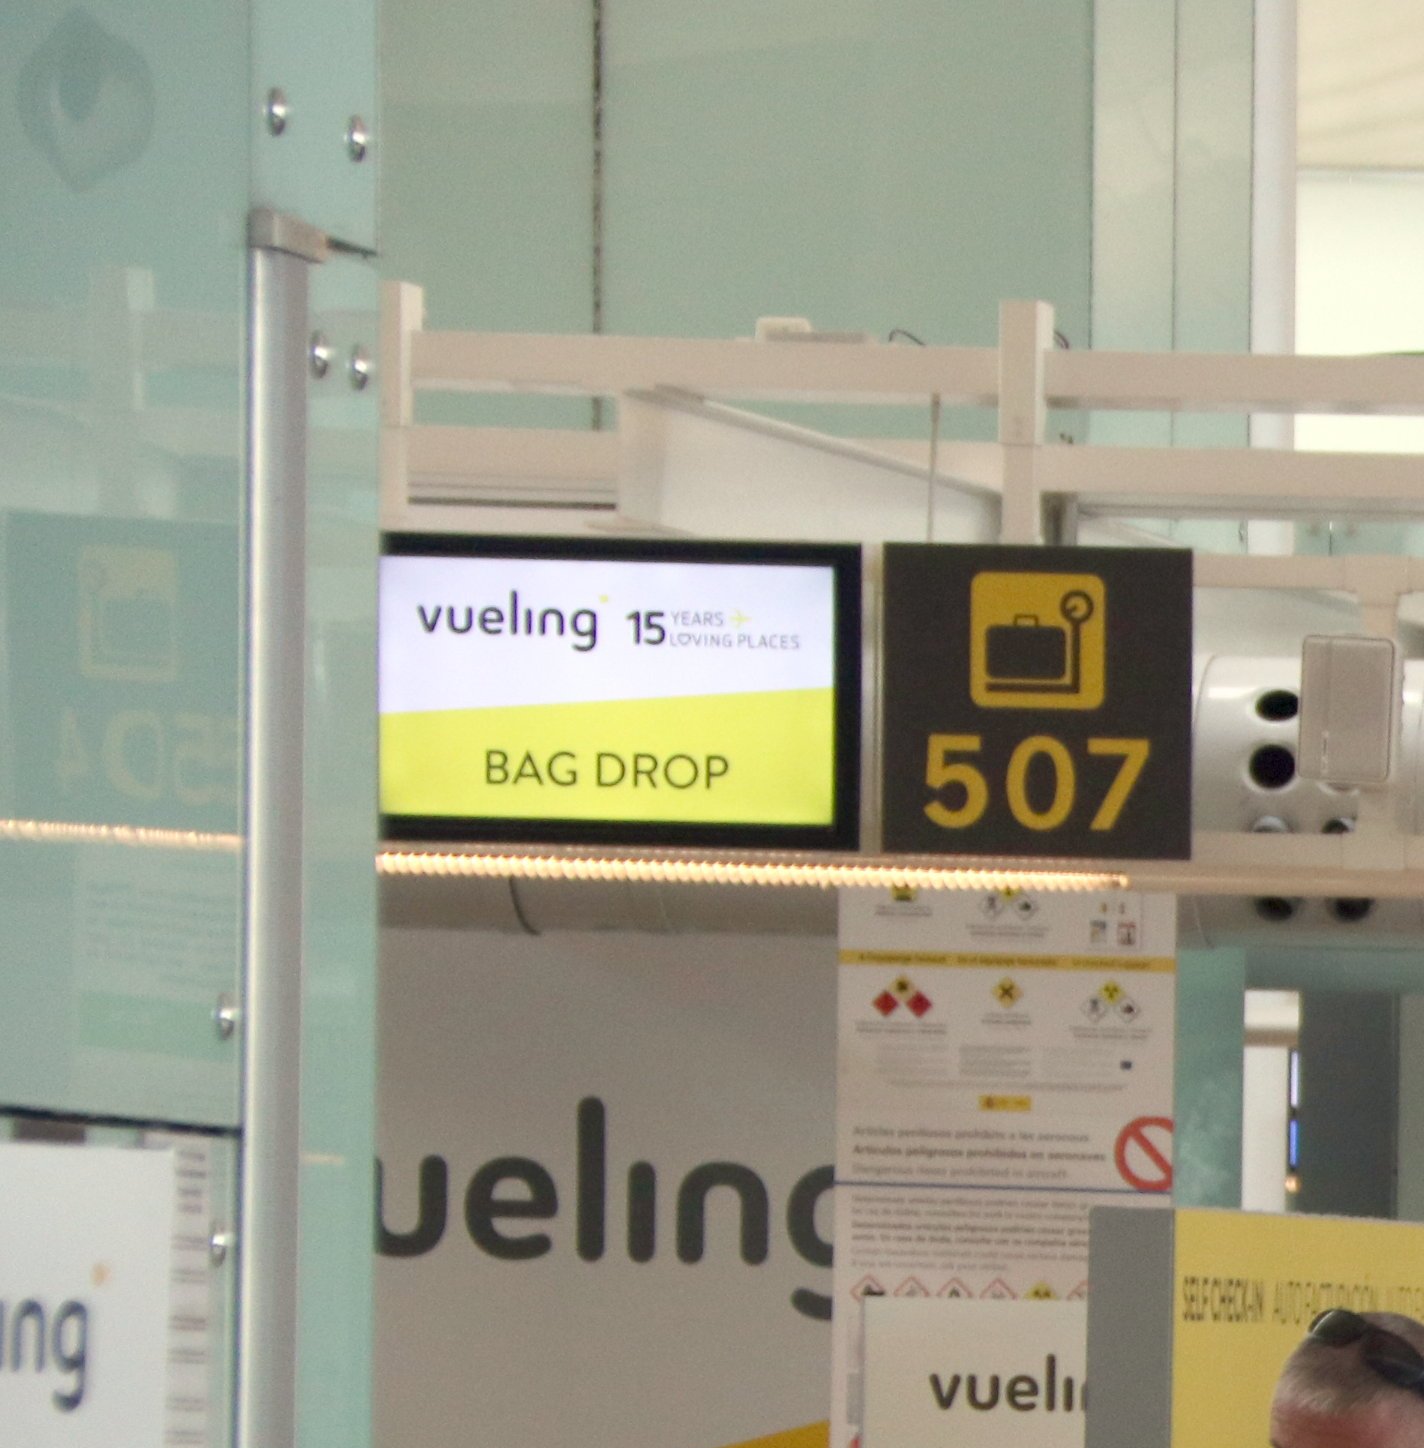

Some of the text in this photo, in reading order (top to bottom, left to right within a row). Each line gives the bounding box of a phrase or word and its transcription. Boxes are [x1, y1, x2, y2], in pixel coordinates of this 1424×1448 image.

[416, 590, 598, 652] vueling
[626, 610, 724, 646] 15 YEARS
[669, 633, 801, 651] LOVING PLACES
[485, 748, 729, 789] BAG DROP
[924, 734, 1151, 832] 507
[929, 1353, 1087, 1413] vueli
